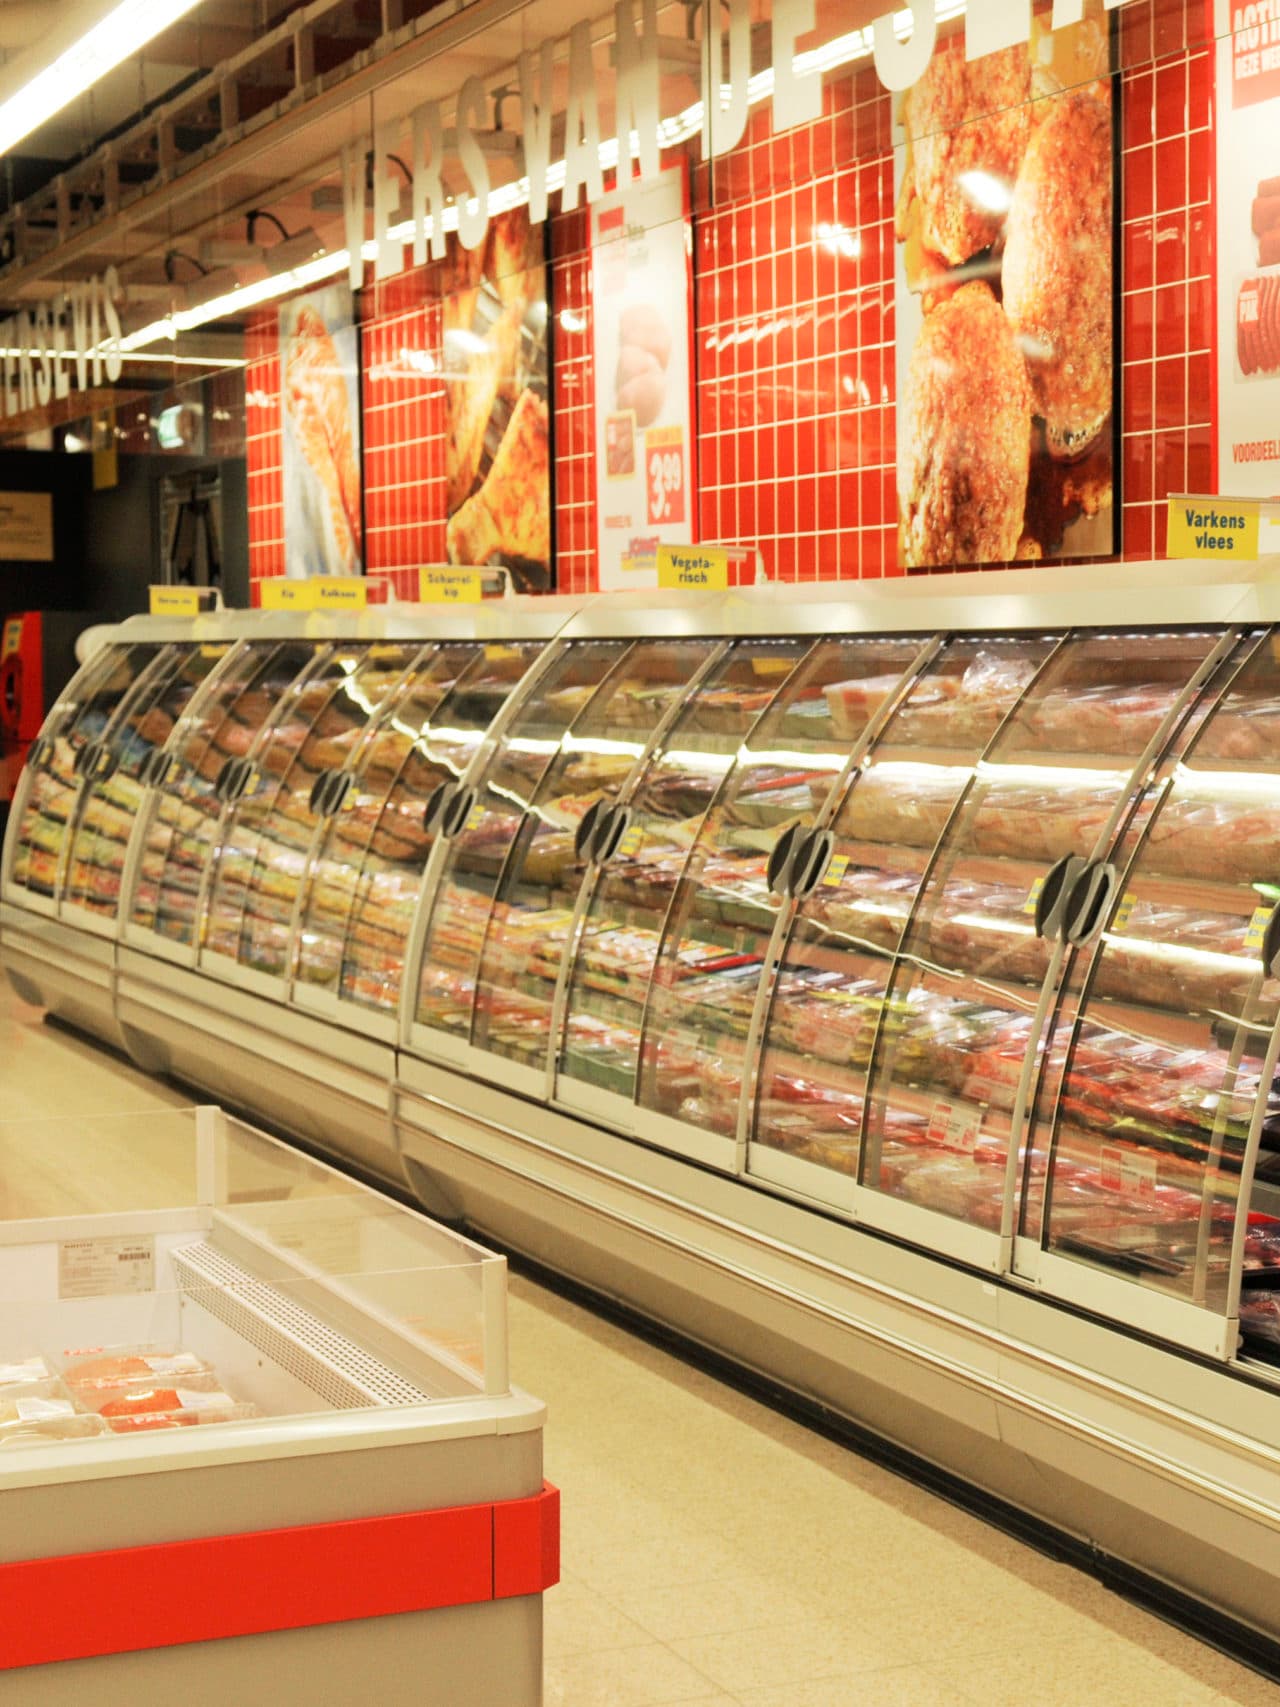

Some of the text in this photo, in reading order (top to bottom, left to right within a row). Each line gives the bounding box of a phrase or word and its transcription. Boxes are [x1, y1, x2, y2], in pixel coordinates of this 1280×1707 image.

[340, 73, 490, 291] VERS
[518, 0, 661, 225] VAN
[2, 293, 70, 417] ERSE
[1186, 510, 1245, 529] Varkens
[1195, 531, 1234, 550] vlees
